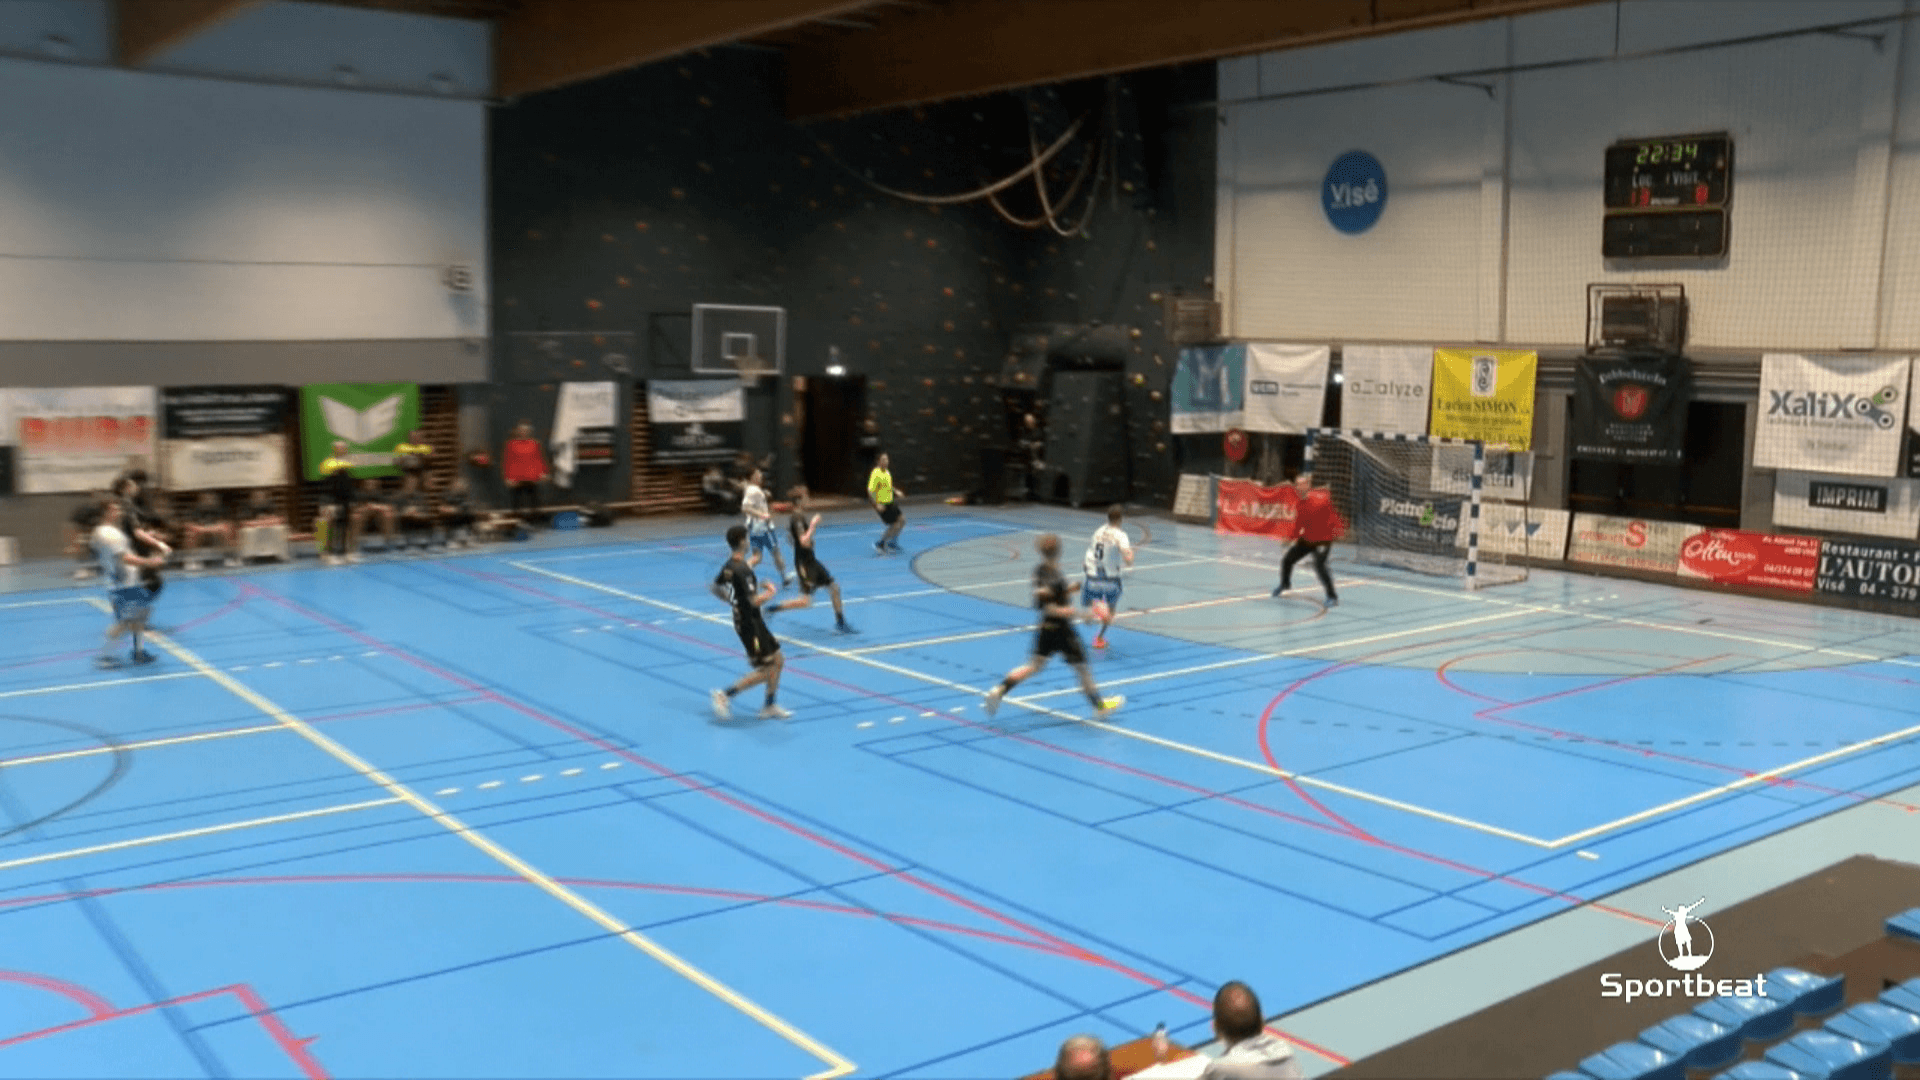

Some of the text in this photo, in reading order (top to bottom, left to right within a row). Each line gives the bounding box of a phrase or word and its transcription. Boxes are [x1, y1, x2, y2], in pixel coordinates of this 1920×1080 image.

[1636, 143, 1698, 164] 22:34
[1330, 177, 1380, 208] Visé
[1473, 400, 1518, 414] SIMON
[1768, 389, 1856, 419] XaliX
[1816, 484, 1880, 509] IMPRIM
[1822, 541, 1899, 560] Restaurant
[1817, 577, 1846, 593] Visé
[1859, 581, 1877, 595] 04
[1890, 585, 1918, 600] 379
